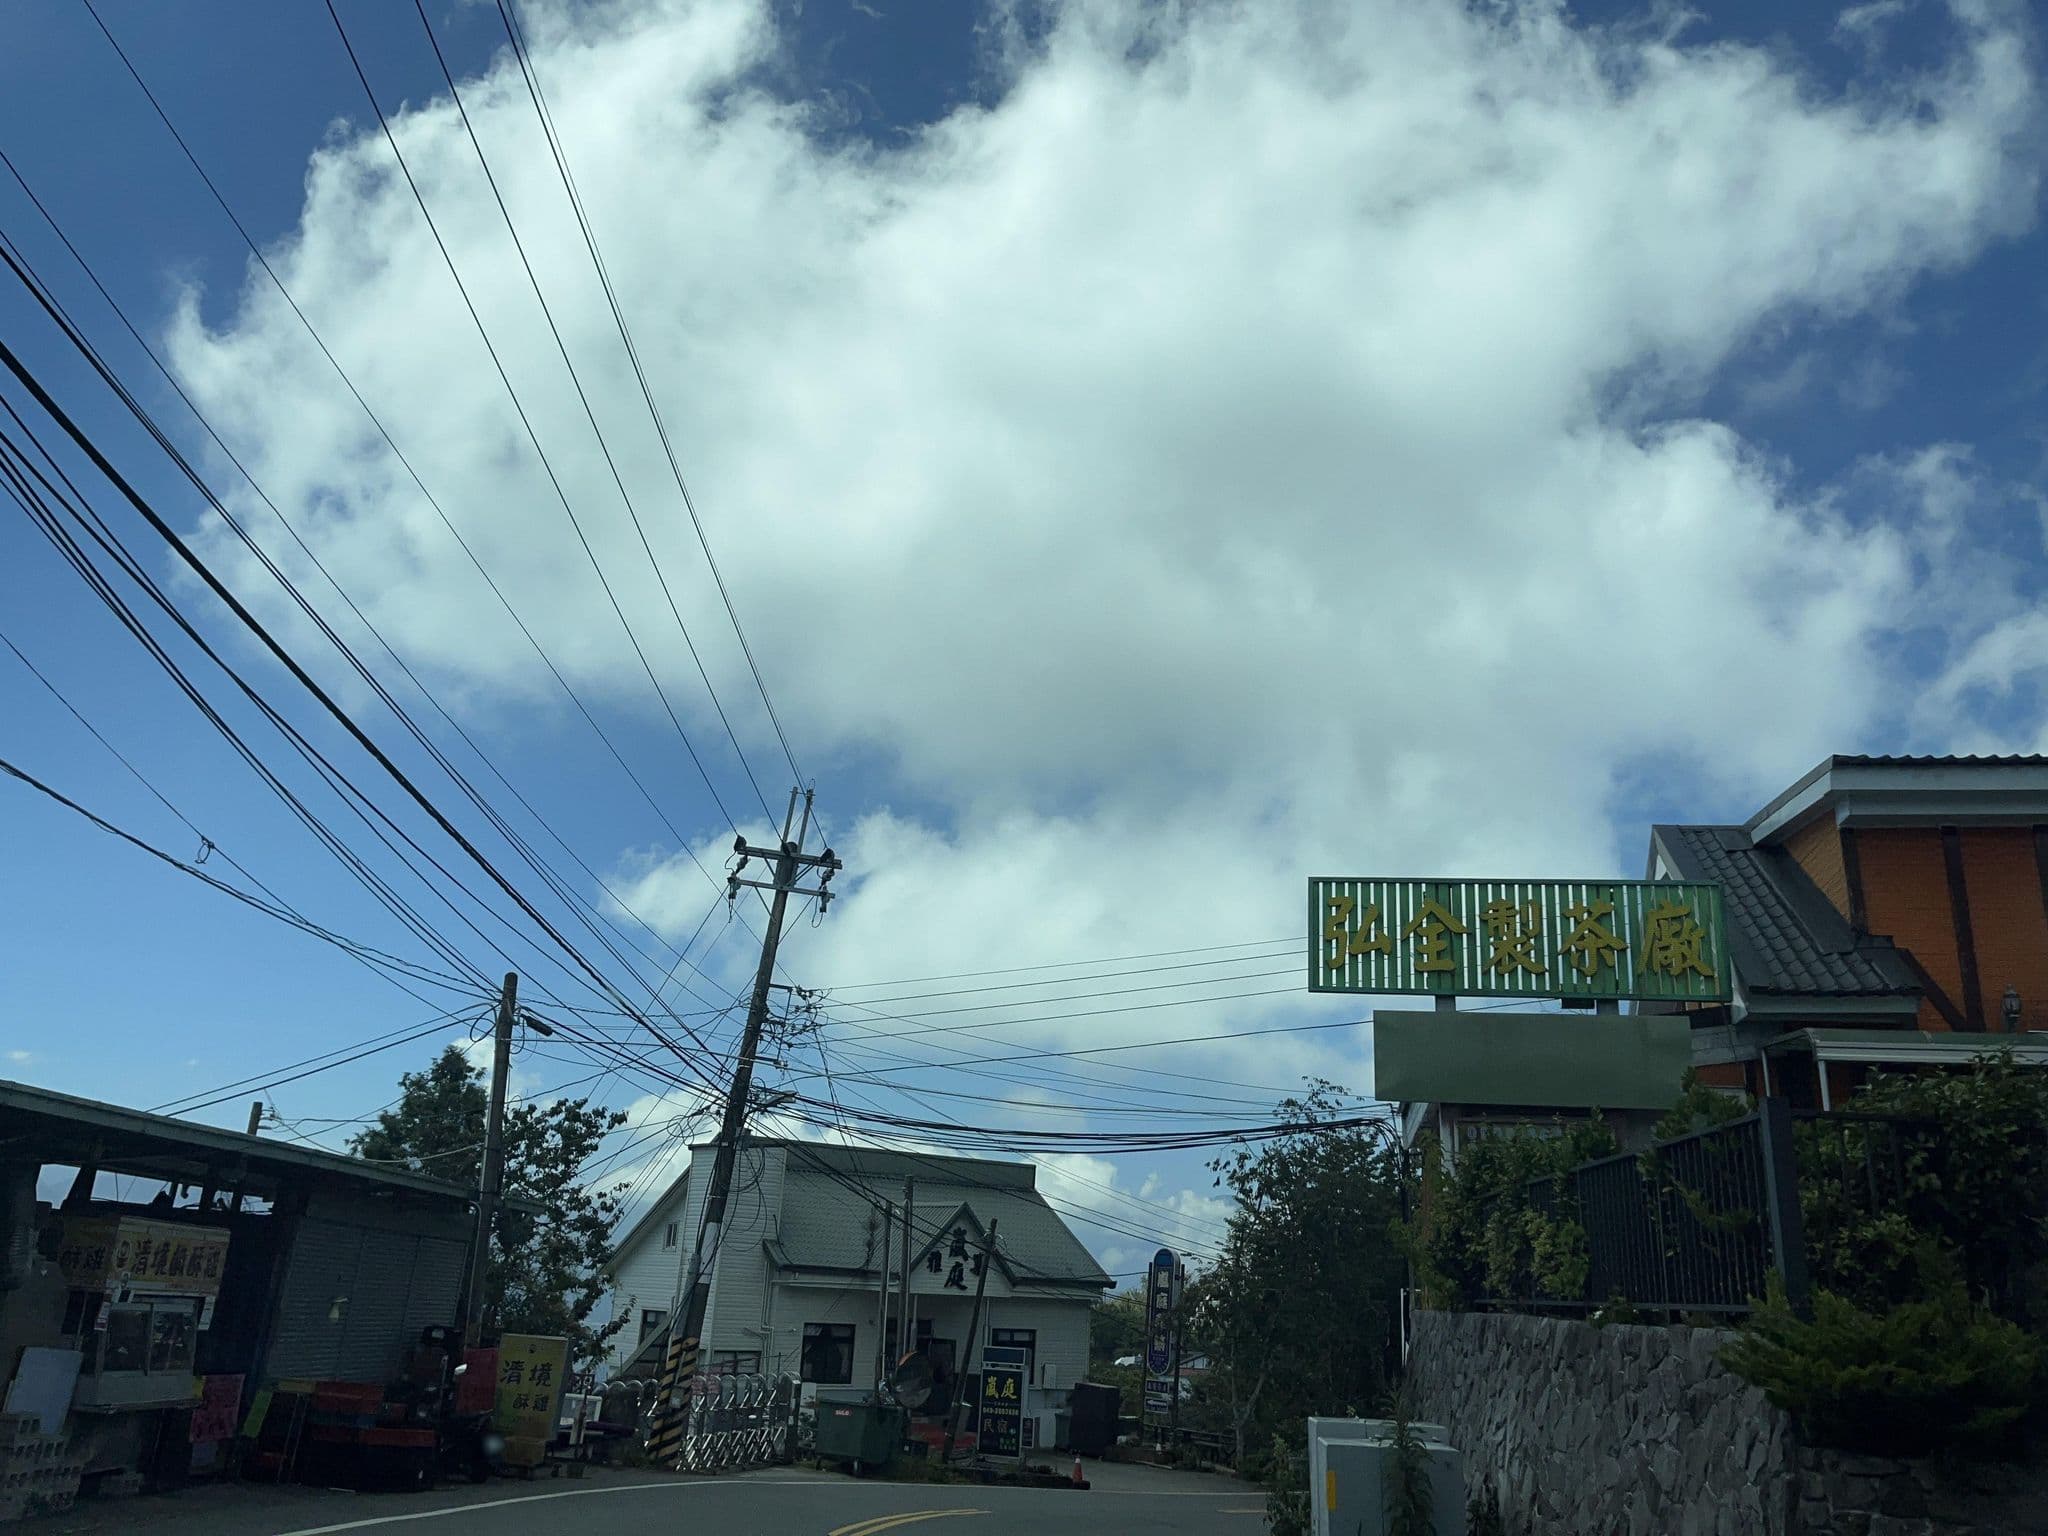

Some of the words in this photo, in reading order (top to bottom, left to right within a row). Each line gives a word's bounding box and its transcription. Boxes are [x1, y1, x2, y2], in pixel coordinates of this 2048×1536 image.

[1326, 895, 1714, 978] 弘全製茶廠
[500, 1360, 553, 1387] 清境
